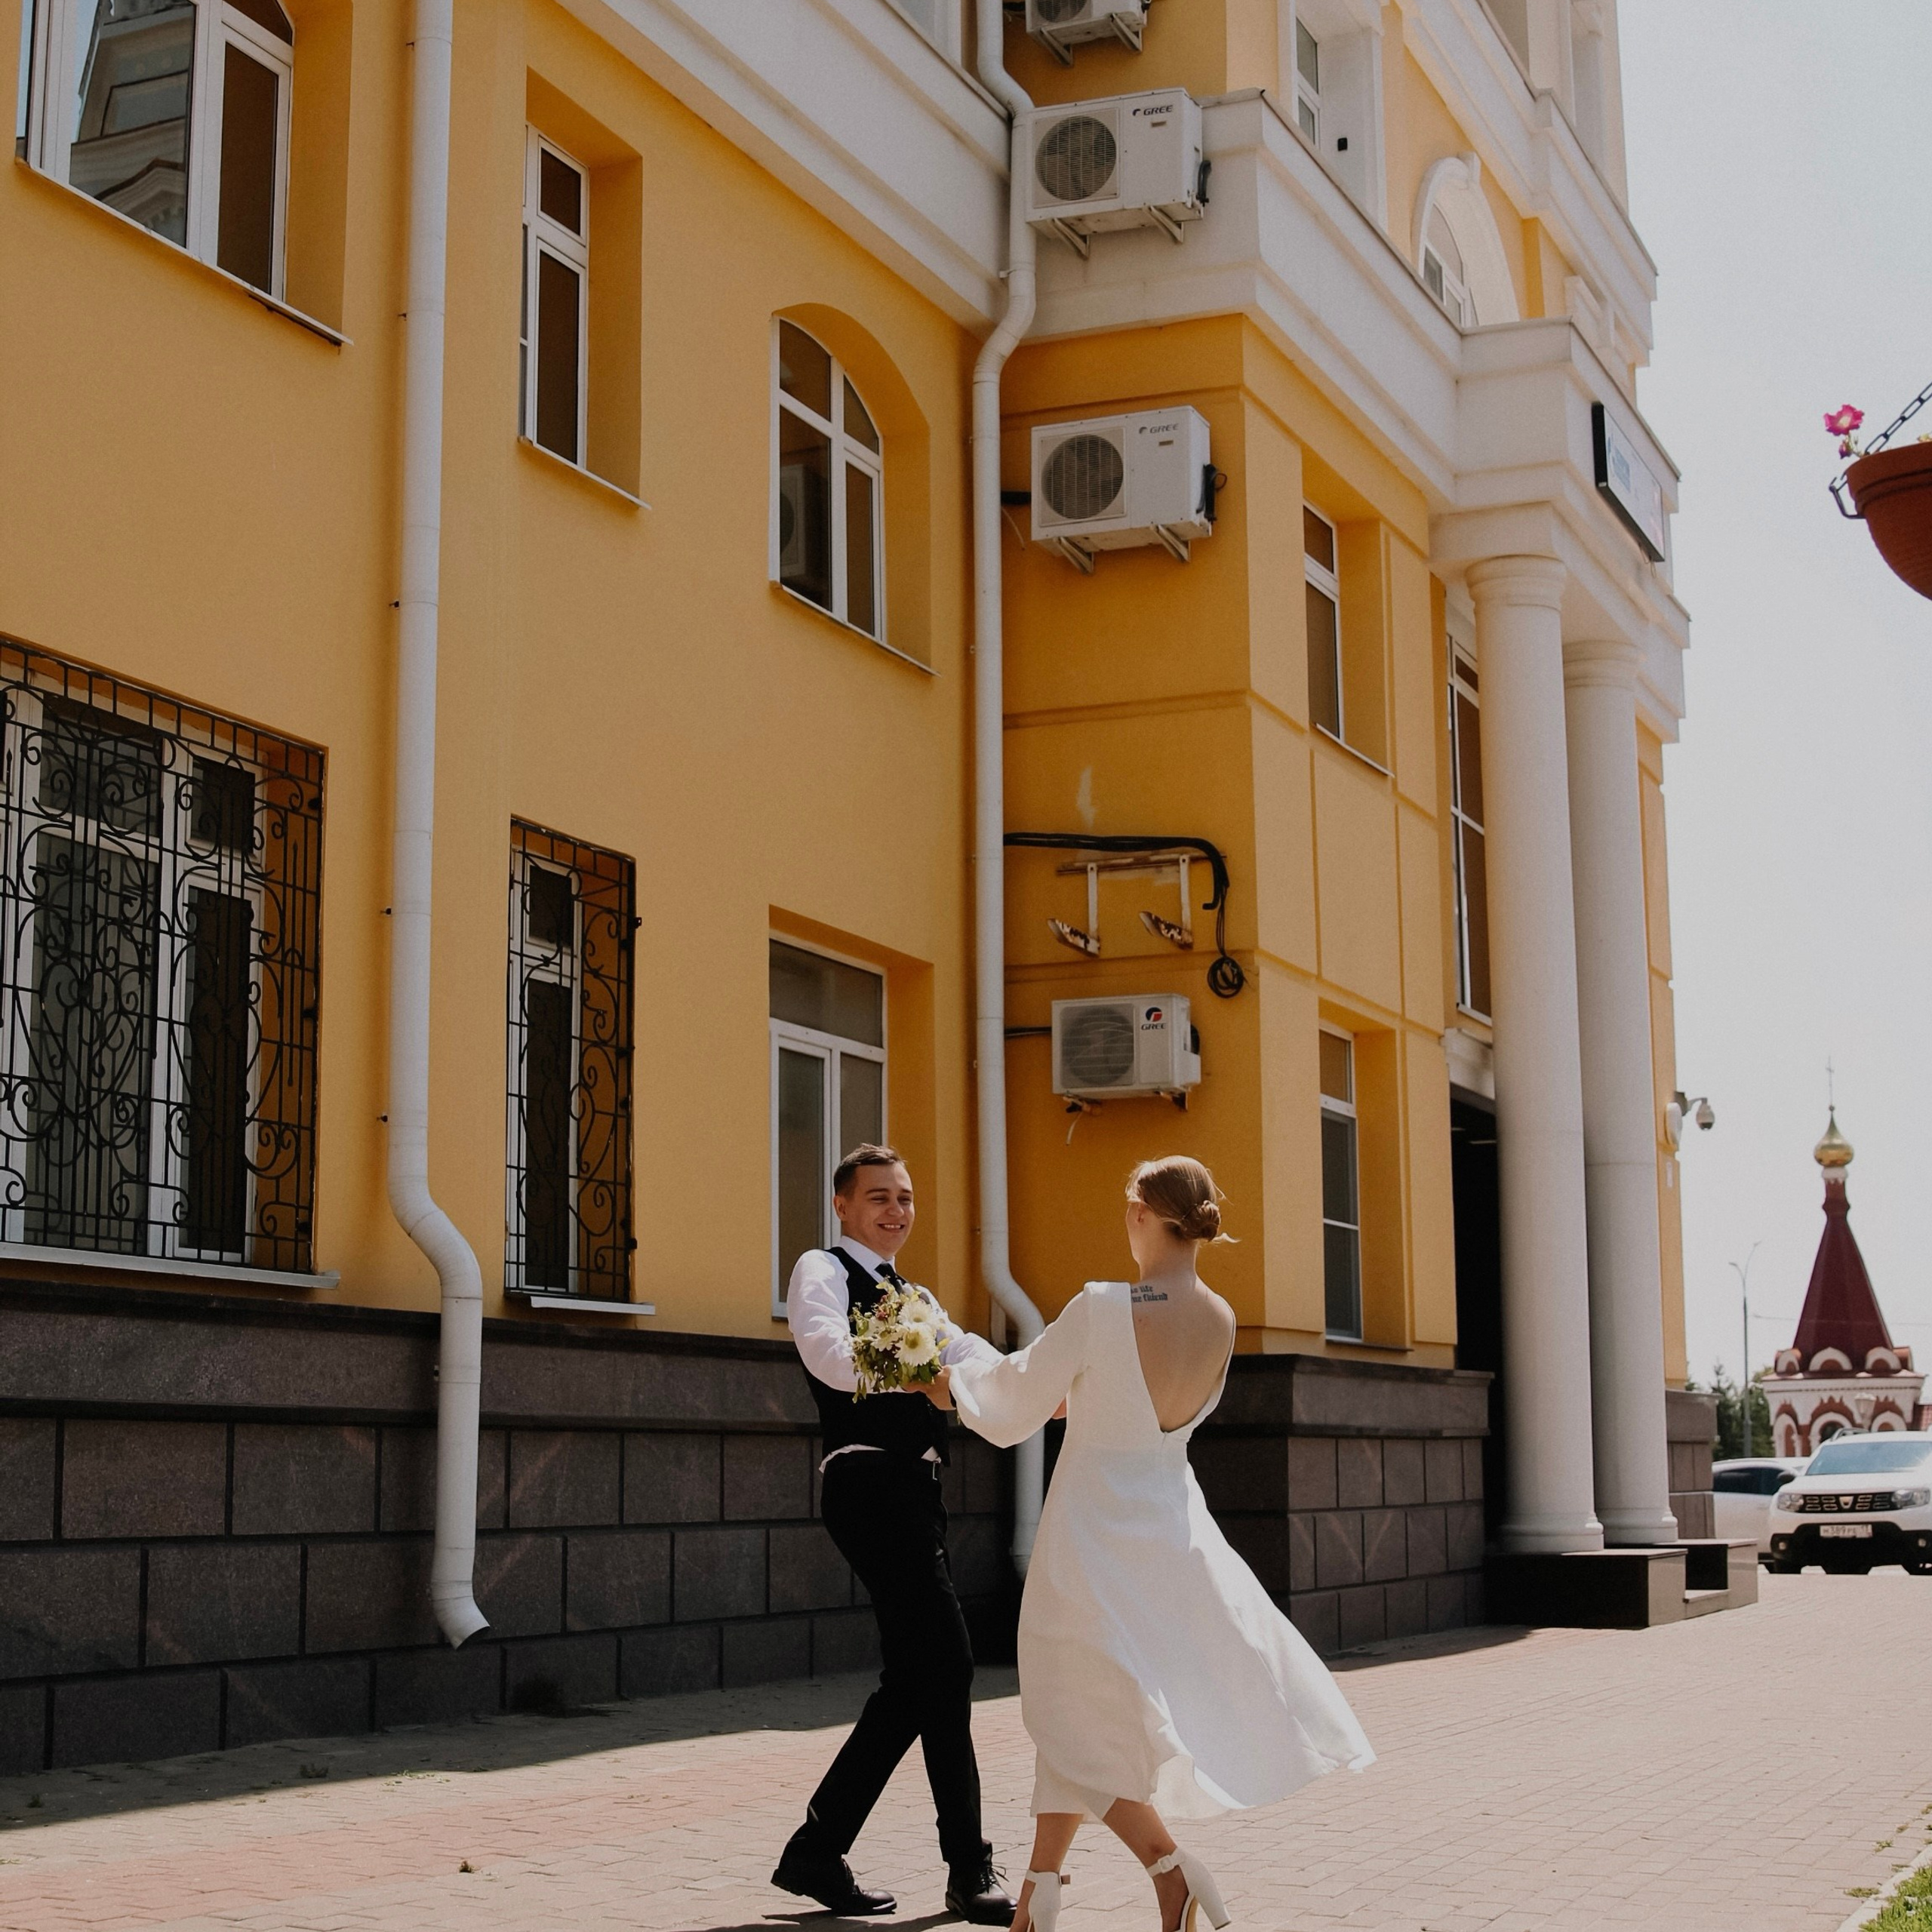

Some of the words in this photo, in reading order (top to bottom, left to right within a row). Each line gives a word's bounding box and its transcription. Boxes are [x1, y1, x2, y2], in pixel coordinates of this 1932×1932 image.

[1143, 105, 1174, 116] GREE
[1149, 423, 1179, 433] GREE
[1141, 1023, 1166, 1031] GREE
